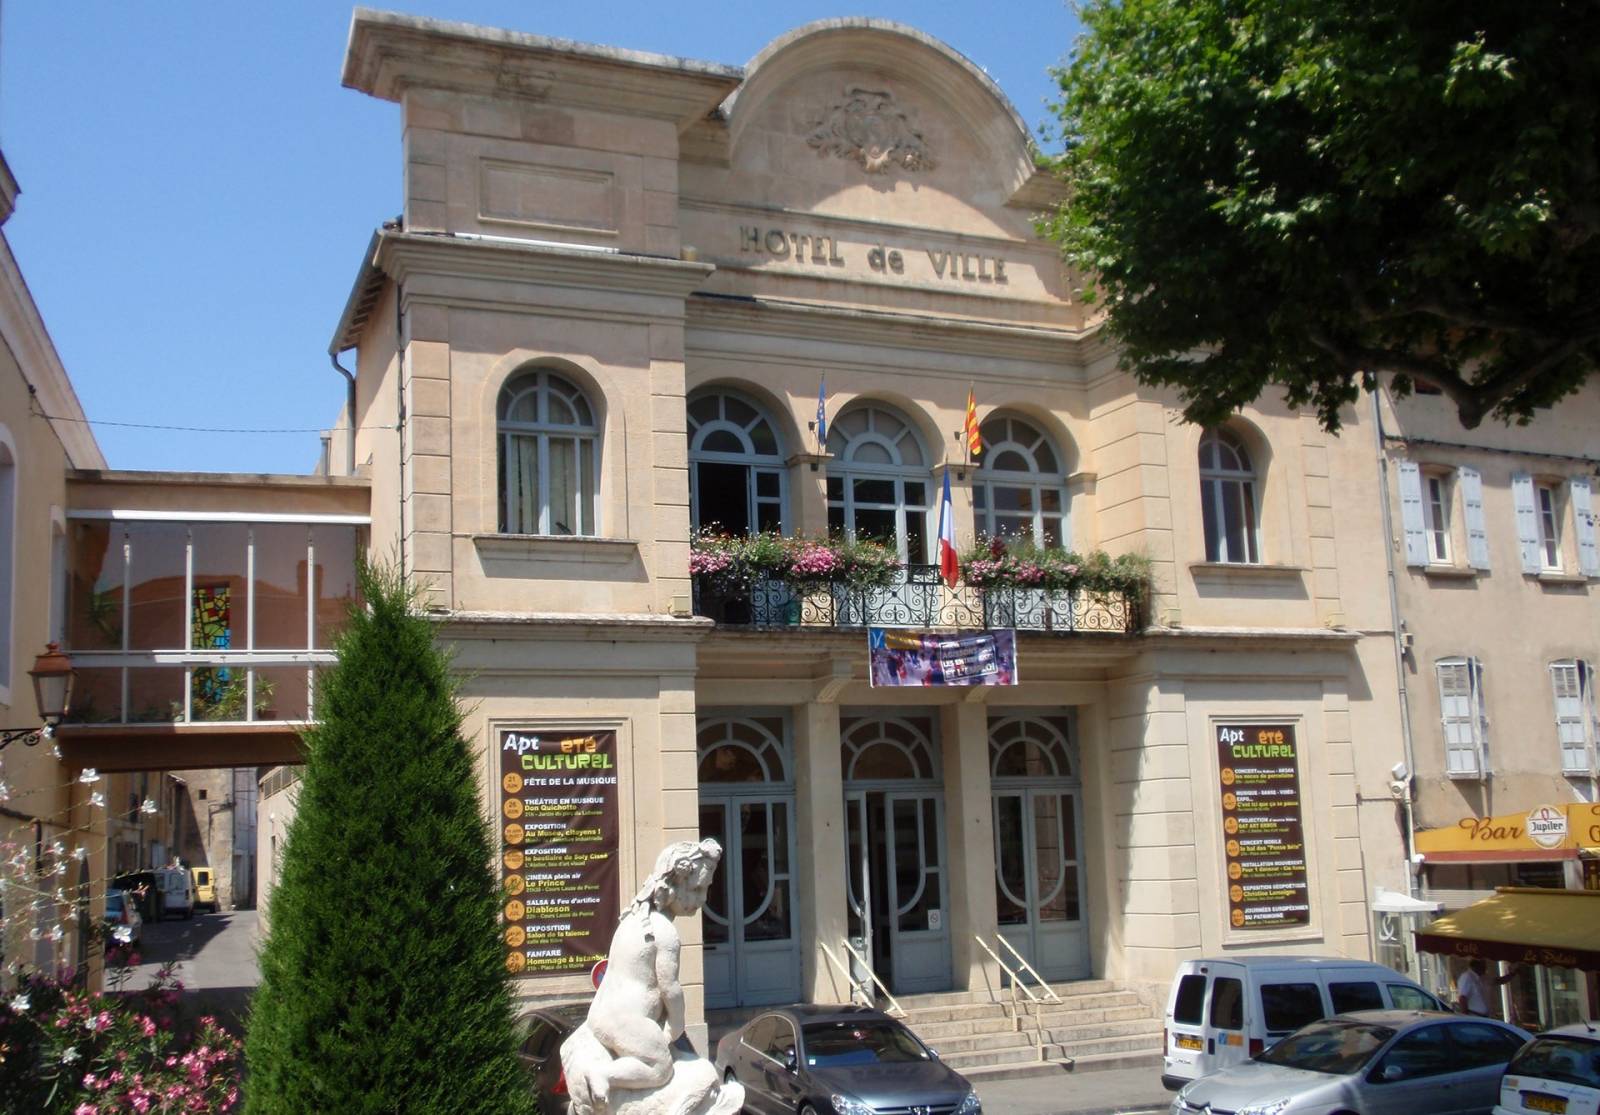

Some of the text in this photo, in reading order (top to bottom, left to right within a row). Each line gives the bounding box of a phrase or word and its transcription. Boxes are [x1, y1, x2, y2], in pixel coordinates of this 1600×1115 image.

[868, 243, 905, 275] de
[927, 248, 1009, 284] VILLE
[1220, 728, 1244, 745] Apt
[504, 734, 539, 755] Apt
[524, 778, 548, 786] FÊTE
[576, 776, 616, 784] MUSIQUE
[1459, 816, 1524, 841] Bar
[1532, 821, 1564, 832] Jupiler
[527, 950, 561, 958] FANFARE
[527, 958, 567, 966] Hommage
